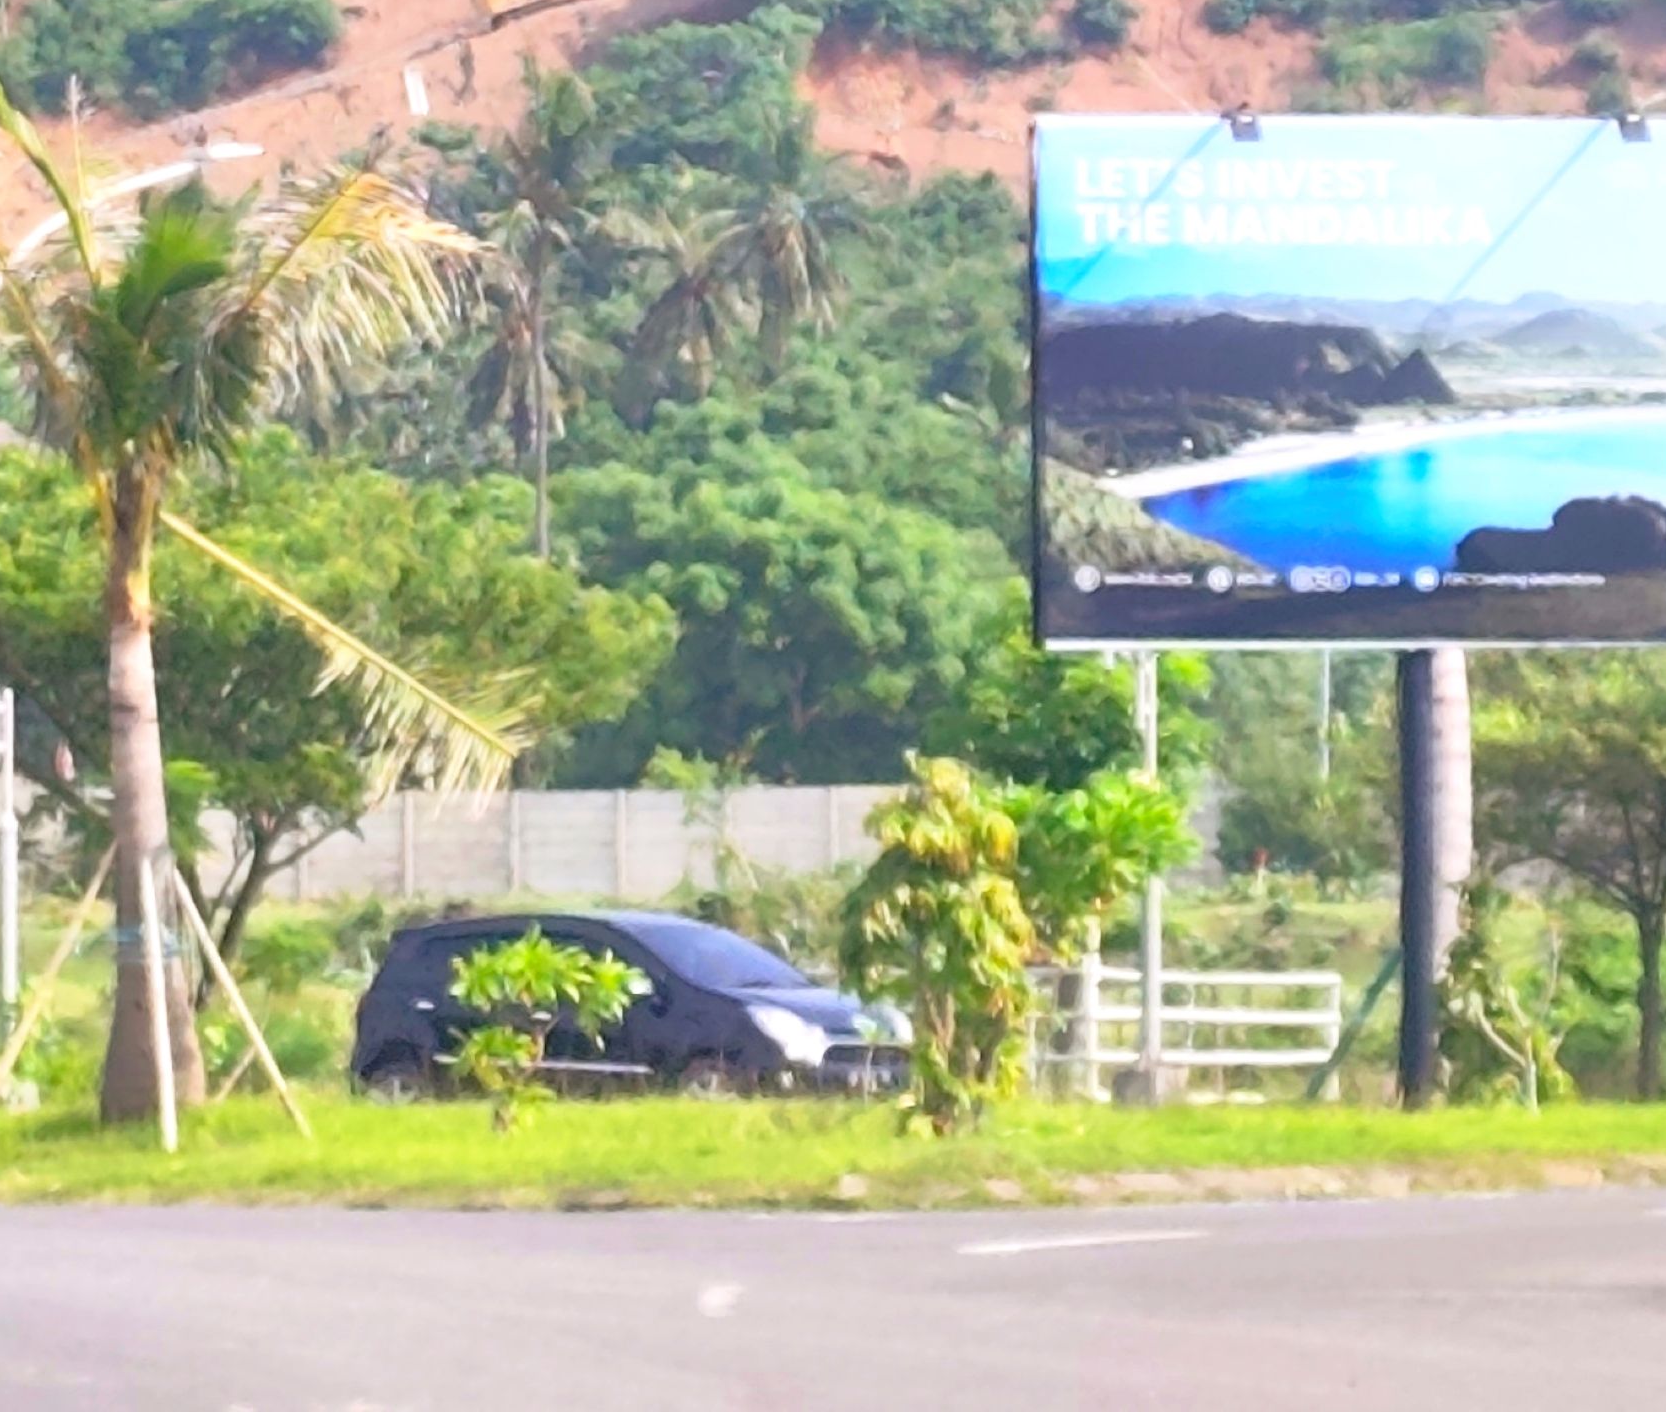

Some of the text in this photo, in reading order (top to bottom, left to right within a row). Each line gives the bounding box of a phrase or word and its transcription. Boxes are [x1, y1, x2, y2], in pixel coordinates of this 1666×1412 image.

[1219, 159, 1395, 198] INVEST
[1077, 204, 1493, 244] THE MANDALIKA
